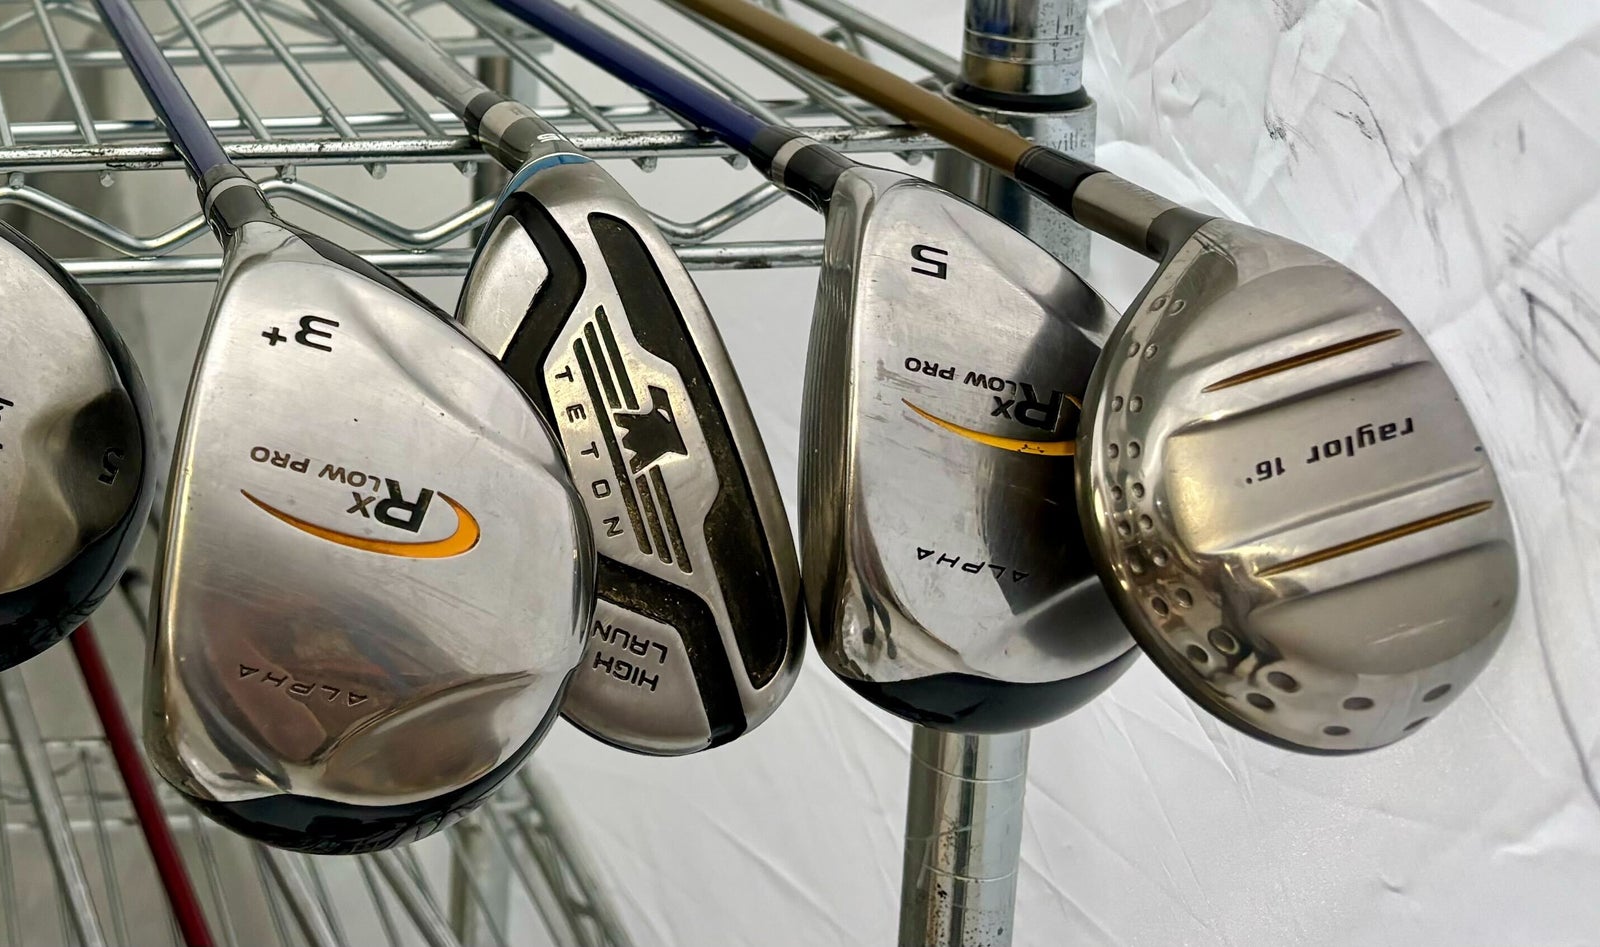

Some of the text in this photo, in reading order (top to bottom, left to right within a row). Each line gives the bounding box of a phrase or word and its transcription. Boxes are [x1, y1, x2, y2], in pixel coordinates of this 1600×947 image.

[911, 244, 948, 280] 5
[905, 357, 1016, 395] LOW PRO
[554, 365, 624, 538] TETON
[1306, 417, 1414, 464] raylor
[250, 446, 381, 492] LOW PRO
[917, 547, 1029, 582] ALPHA
[592, 620, 668, 664] LAUN
[239, 664, 368, 706] ALPHA
[592, 651, 659, 692] HIGH
